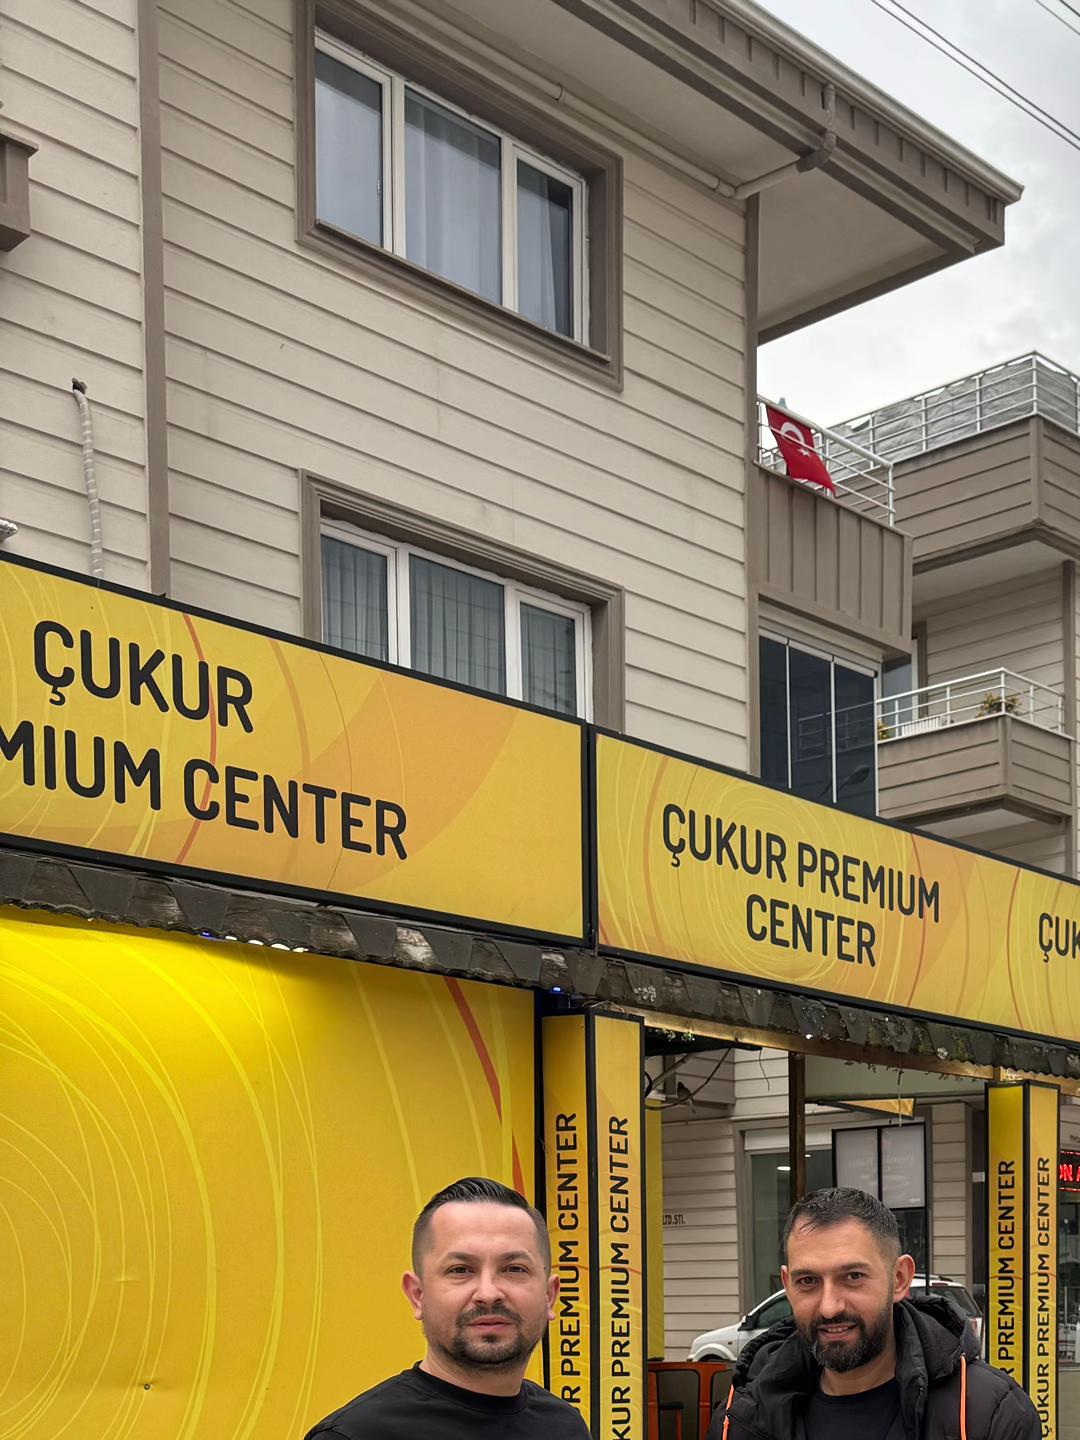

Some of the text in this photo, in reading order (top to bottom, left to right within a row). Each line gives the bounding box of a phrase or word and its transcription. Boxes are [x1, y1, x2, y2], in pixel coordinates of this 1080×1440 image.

[33, 619, 254, 734] ÇUKUR
[183, 758, 409, 861] CENTER
[662, 803, 941, 924] ÇUKUR PREMIUM
[746, 894, 877, 968] CENTER
[556, 1112, 579, 1232] CENTER
[608, 1114, 629, 1234] CENTER
[997, 1160, 1015, 1251] CENTER
[559, 1239, 582, 1379] PREMIUM
[610, 1240, 631, 1379] PREMIUM
[997, 1257, 1015, 1361] PREMIUM
[1036, 1157, 1053, 1438] ÇUKUR PREMIUM CENTER
